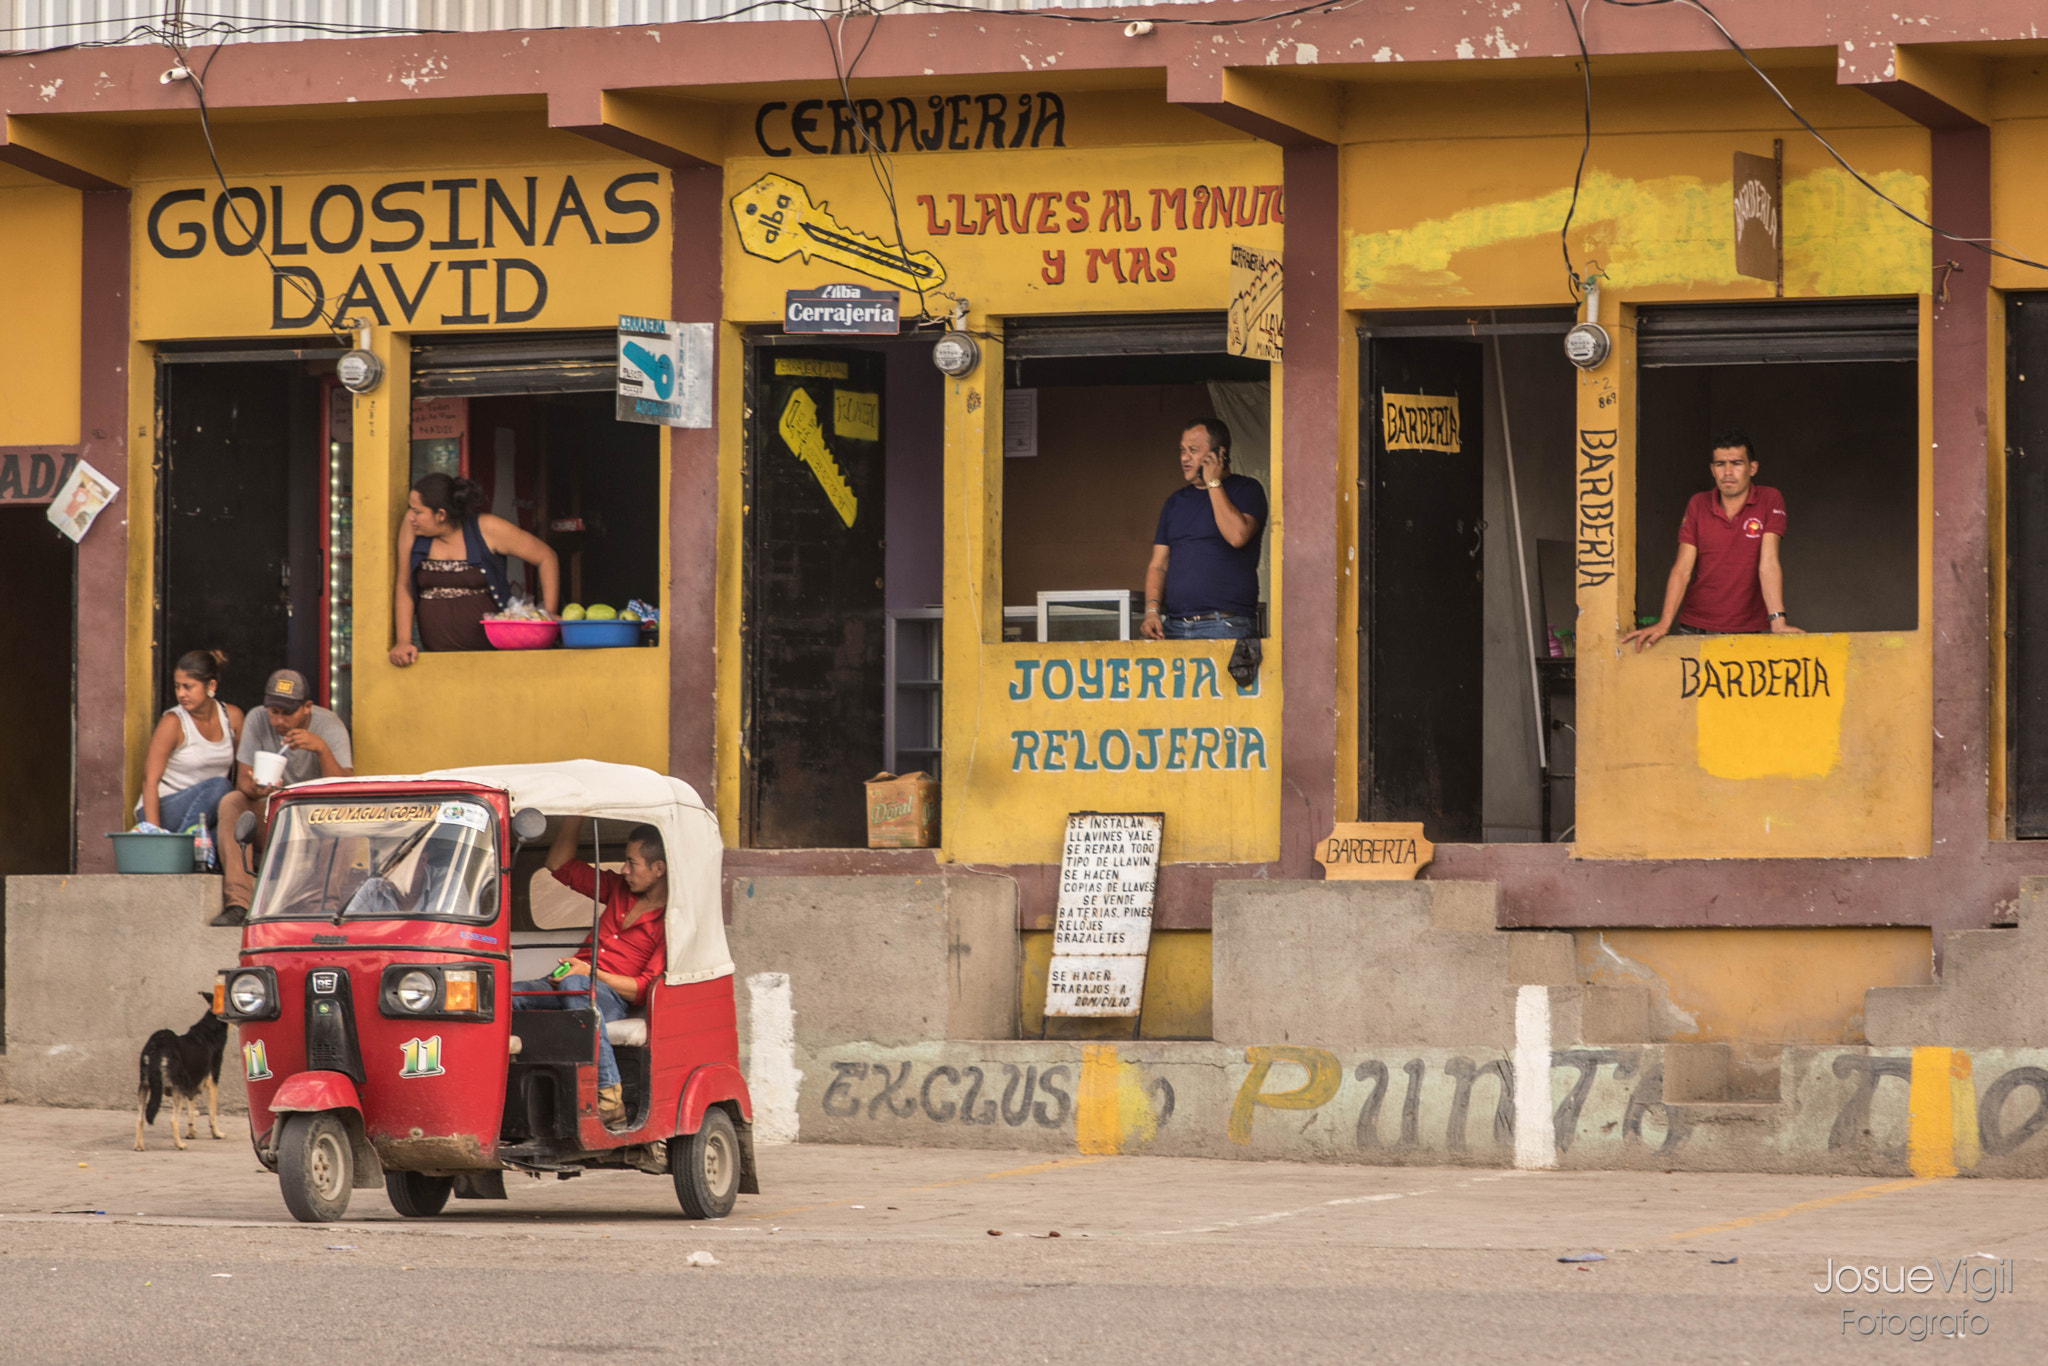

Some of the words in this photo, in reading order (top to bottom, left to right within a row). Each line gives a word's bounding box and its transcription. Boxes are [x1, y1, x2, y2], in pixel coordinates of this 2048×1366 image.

[756, 92, 1066, 157] CERRAJERIA
[147, 172, 660, 260] GOLOSINAS
[758, 194, 792, 244] alba
[917, 191, 1090, 235] LLAVES
[1099, 189, 1142, 232] AL
[1734, 179, 1778, 249] BARBERIA
[1086, 247, 1178, 284] MAS
[271, 258, 548, 330] DAVID
[788, 303, 895, 326] Cerrajería
[1387, 403, 1460, 446] BARBERIA
[1577, 429, 1618, 589] BARBERIA
[1009, 657, 1224, 702] JOYERIA
[1680, 657, 1831, 699] BARBERIA
[1011, 725, 1270, 773] RELOJERIA
[1069, 831, 1122, 842] LLAVINES
[1128, 830, 1153, 841] YALE
[1070, 818, 1084, 829] SE
[1090, 818, 1144, 829] INSTALAN
[1066, 857, 1089, 867] TIPO
[1096, 857, 1109, 867] DE
[1114, 856, 1150, 867] LLAVIN
[1067, 844, 1080, 855] SE
[1085, 844, 1125, 855] REPARA
[1131, 843, 1155, 854] TODO
[1326, 838, 1417, 864] BARBERIA
[1064, 869, 1078, 880] SE
[1084, 869, 1119, 880] HACEN
[1064, 882, 1102, 893] COPIAS
[1107, 882, 1118, 893] DE
[1122, 882, 1155, 893] LLAVES
[1083, 895, 1097, 906] SE
[1104, 895, 1135, 905] VENDE
[1124, 907, 1153, 918] PINES
[1057, 933, 1125, 944] BRAZALETES
[1059, 920, 1103, 931] RELOJES
[1052, 971, 1066, 981] SE
[1073, 970, 1112, 981] HACEN
[1052, 983, 1110, 994] TRABAJOS
[1120, 983, 1126, 994] A
[1075, 997, 1130, 1008] DOMICILIO
[243, 1039, 274, 1081] 11
[399, 1035, 446, 1079] 11
